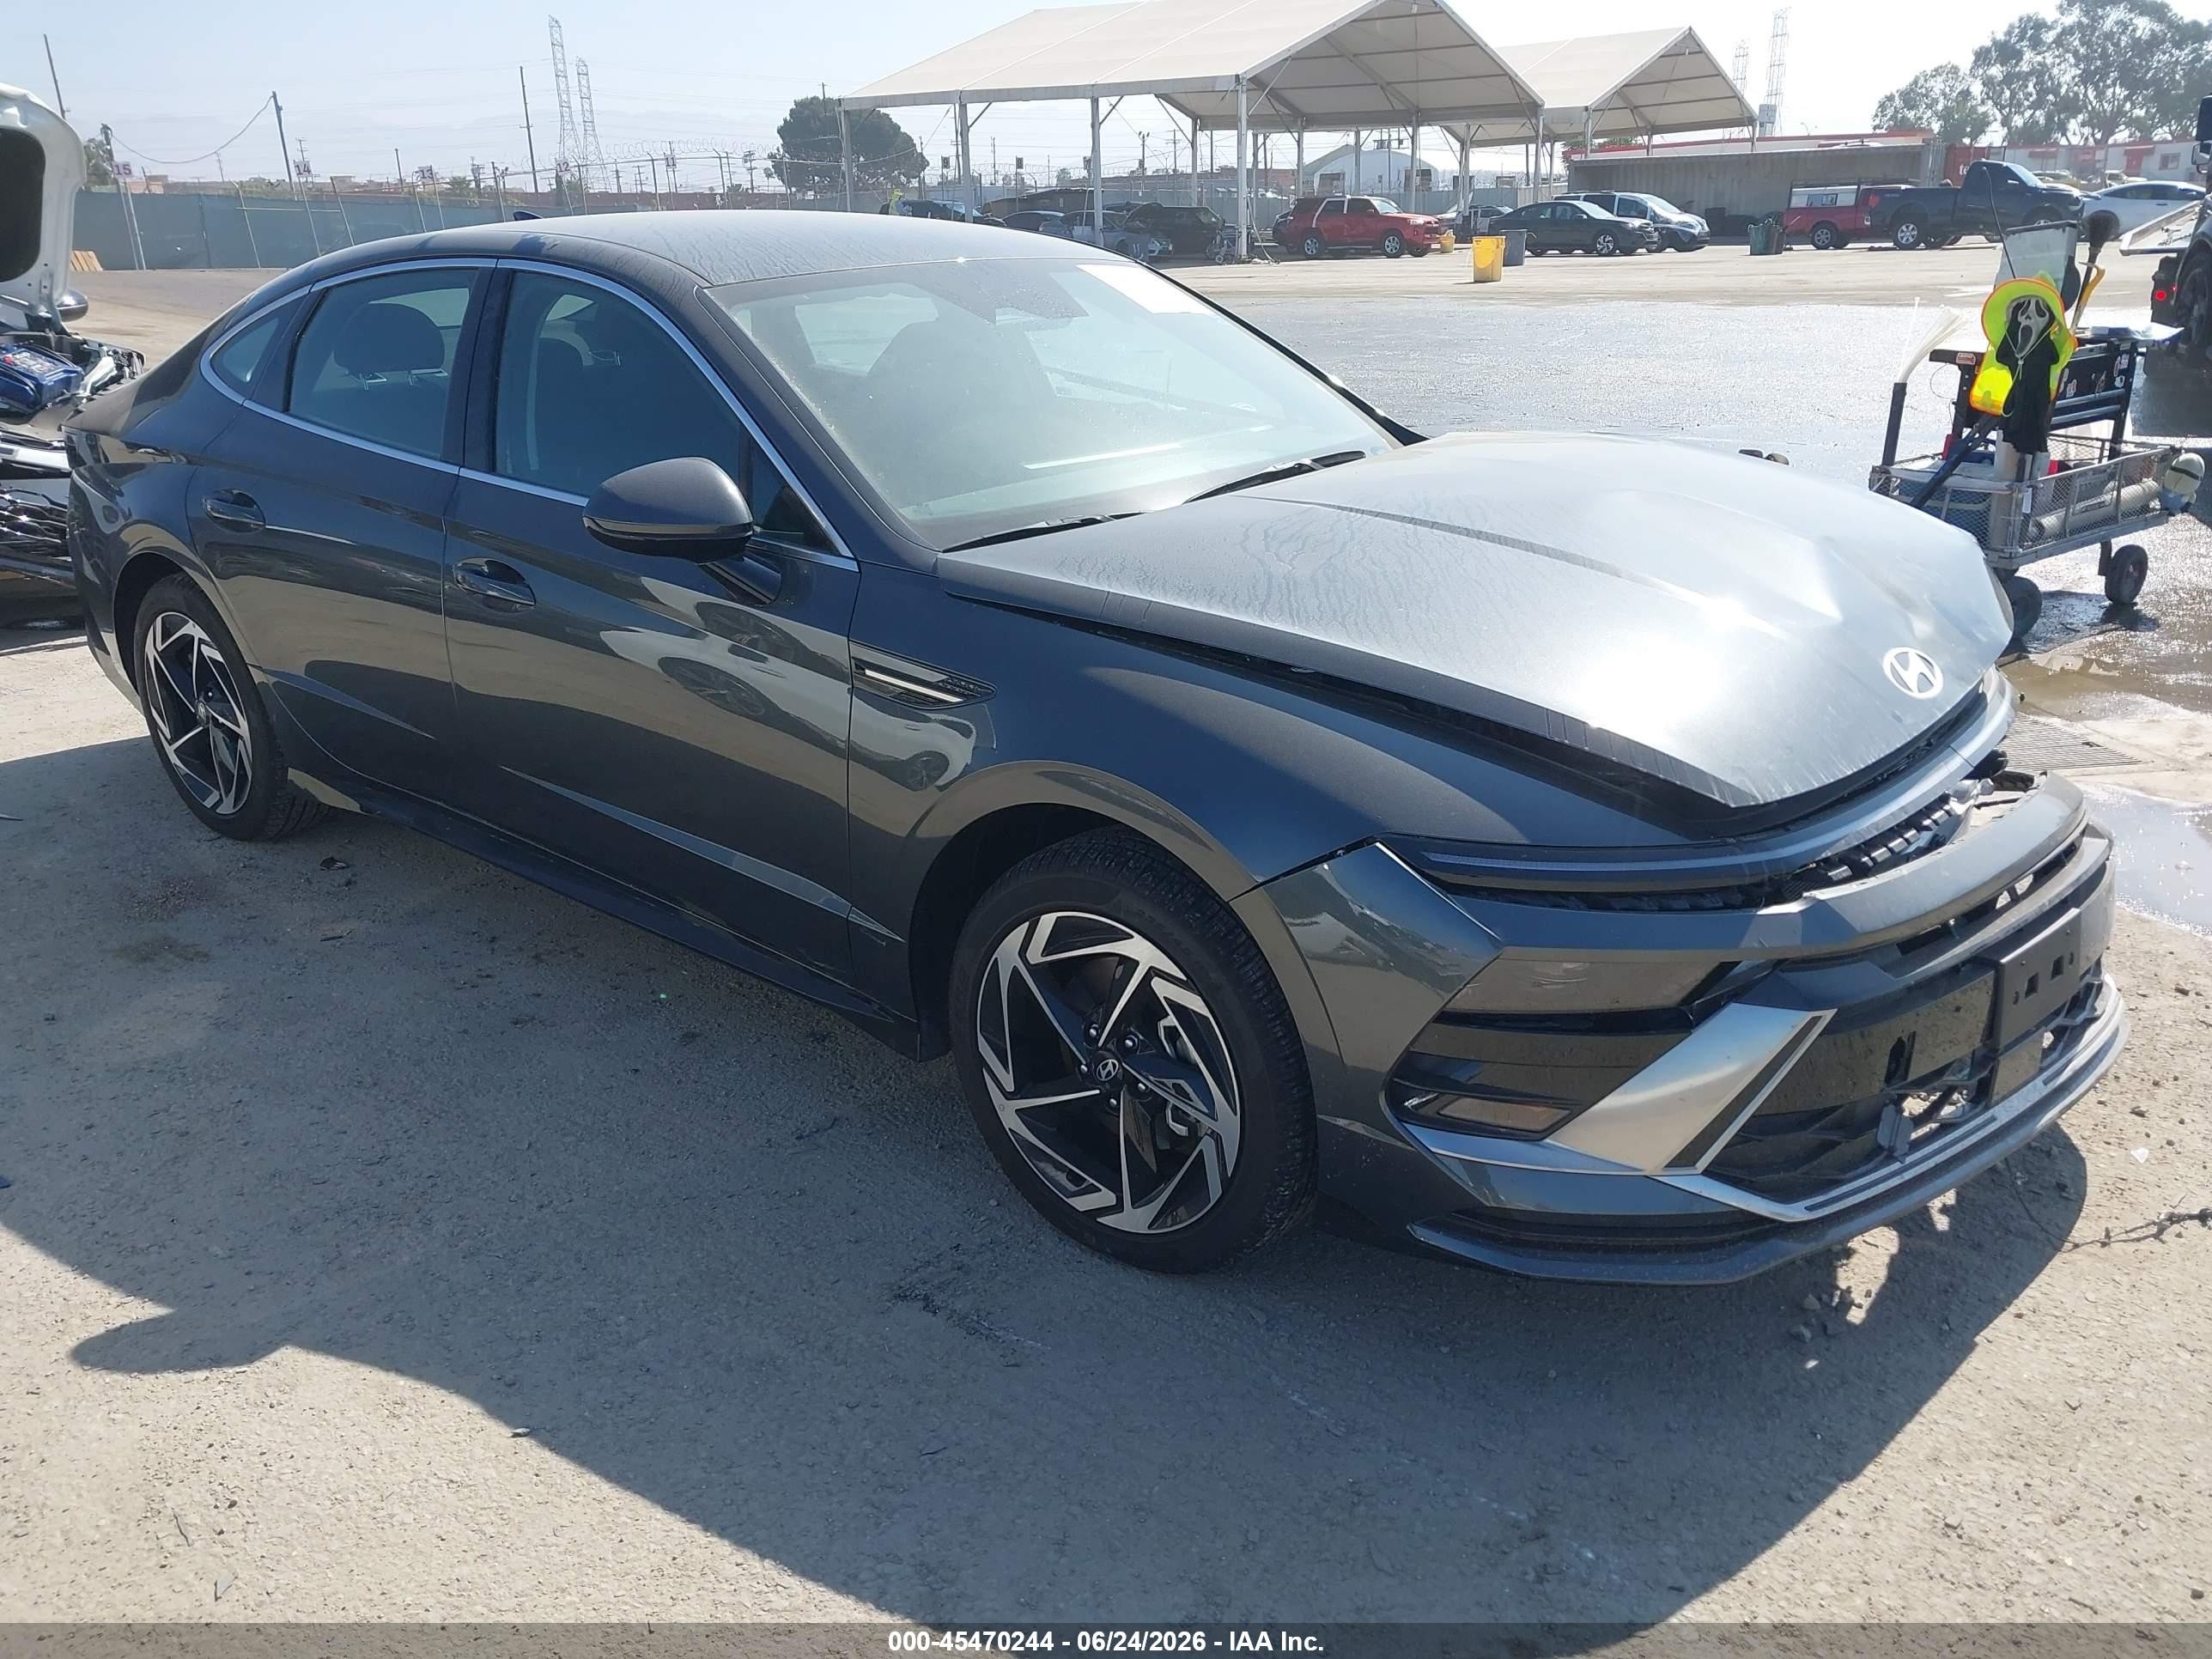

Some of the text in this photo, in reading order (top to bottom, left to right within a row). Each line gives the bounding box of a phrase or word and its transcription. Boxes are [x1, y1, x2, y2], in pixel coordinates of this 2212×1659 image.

[665, 156, 677, 167] 11
[943, 158, 949, 168] 9
[115, 164, 132, 176] 15
[295, 163, 312, 176] 14
[556, 162, 570, 173] 12
[419, 169, 434, 179] 13
